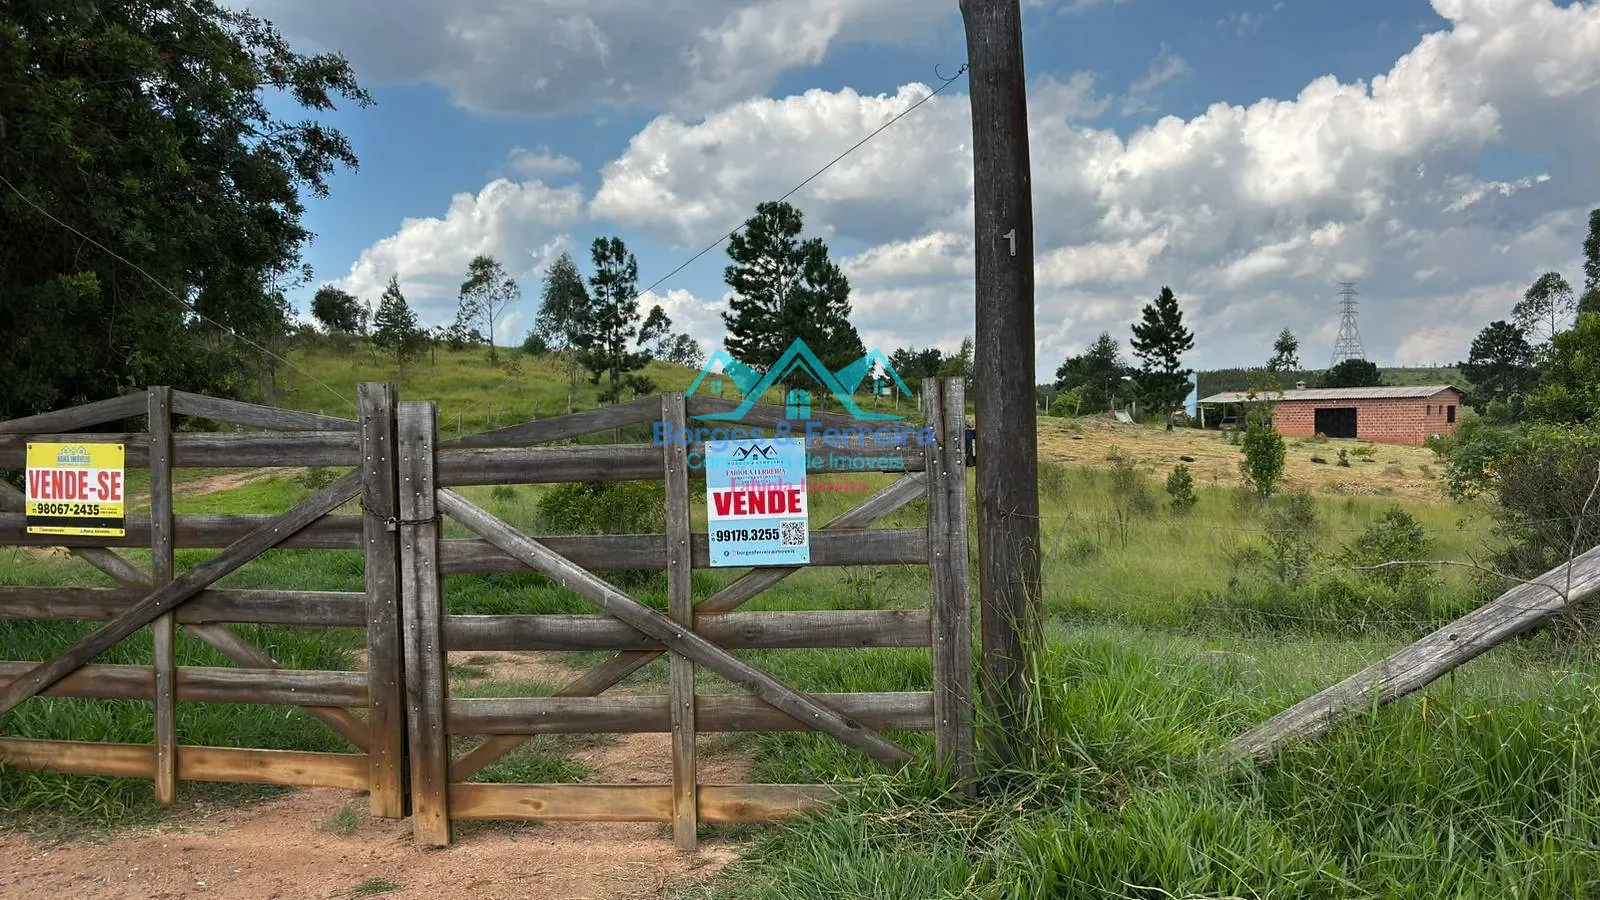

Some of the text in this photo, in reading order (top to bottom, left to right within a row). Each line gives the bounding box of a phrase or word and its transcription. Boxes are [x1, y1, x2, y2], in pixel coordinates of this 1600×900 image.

[29, 470, 121, 500] VENDE-SE
[38, 503, 99, 515] 98067-2435
[713, 489, 802, 516] VENDE
[716, 528, 780, 541] 99179.3255
